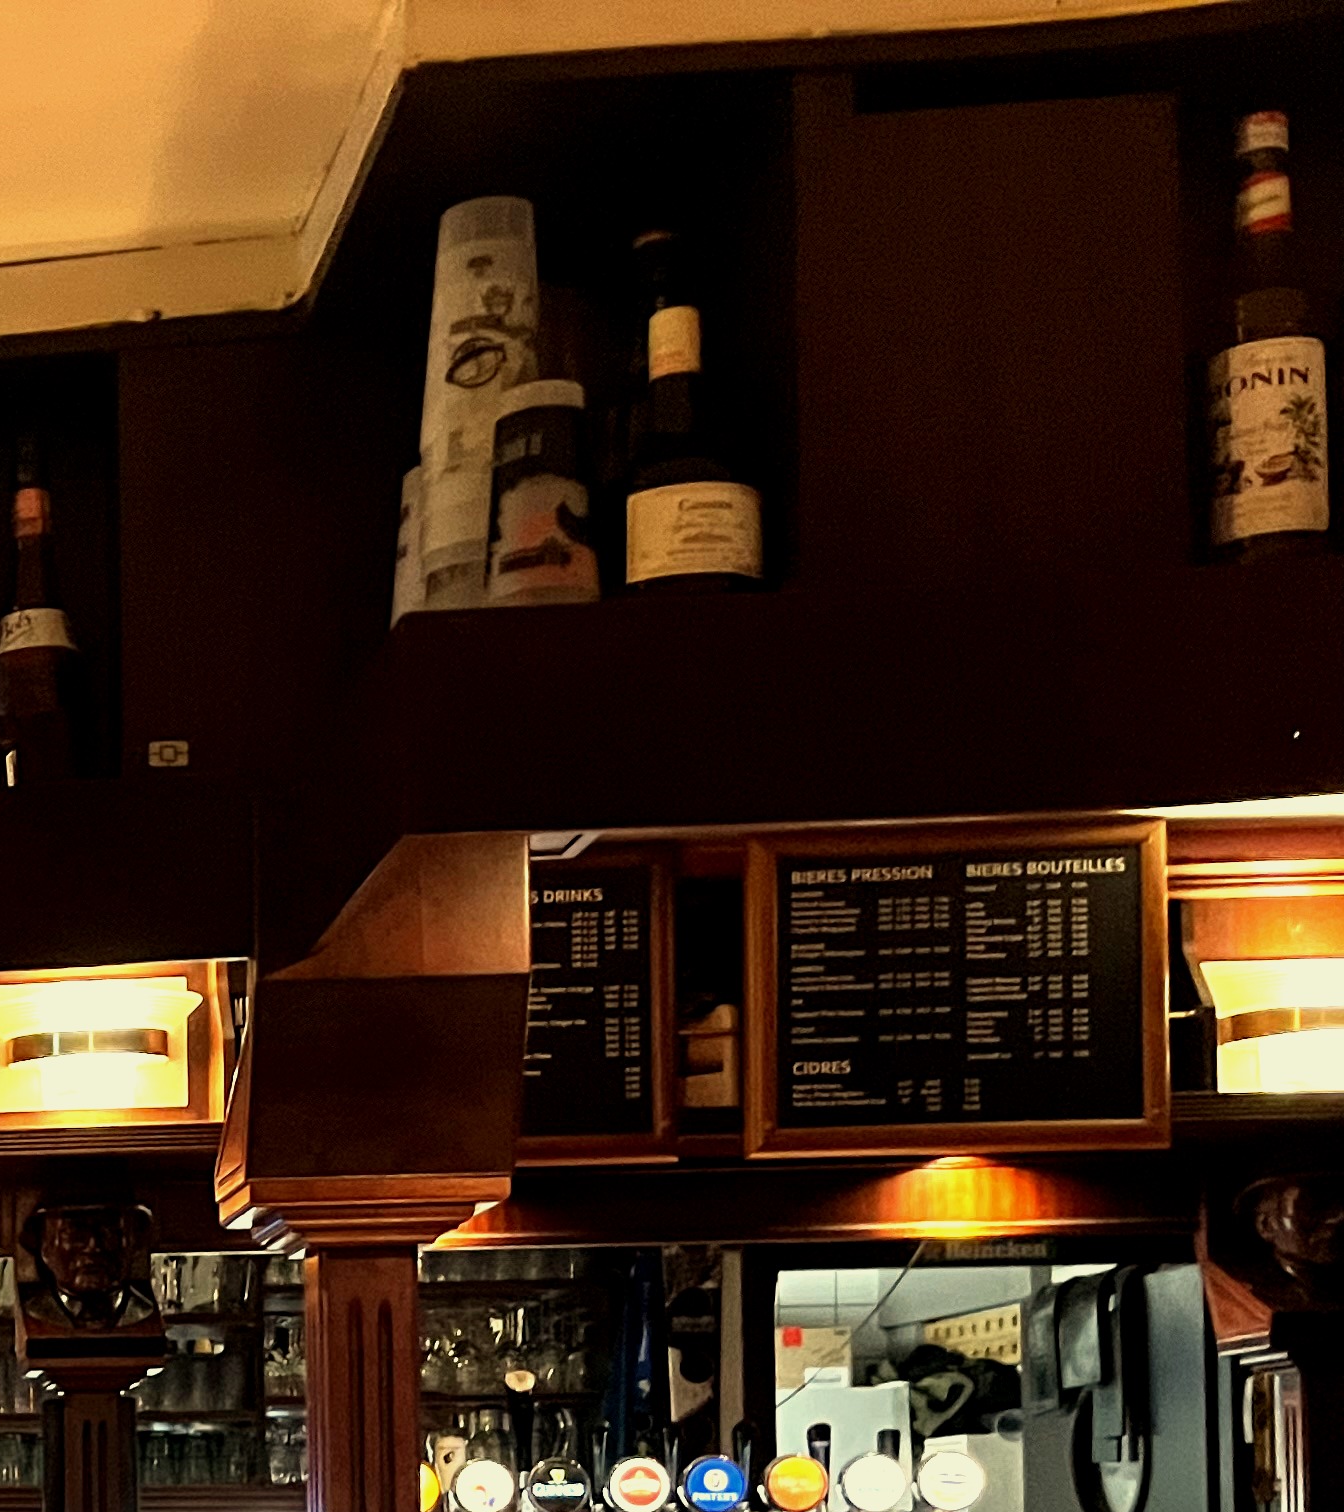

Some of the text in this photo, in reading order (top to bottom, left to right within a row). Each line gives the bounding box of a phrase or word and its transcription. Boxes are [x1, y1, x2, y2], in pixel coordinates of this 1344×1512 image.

[850, 865, 933, 882] PRESSION
[1026, 857, 1126, 876] BOUTEILLES
[543, 888, 604, 904] DRINKS
[792, 1060, 851, 1076] CIDRES
